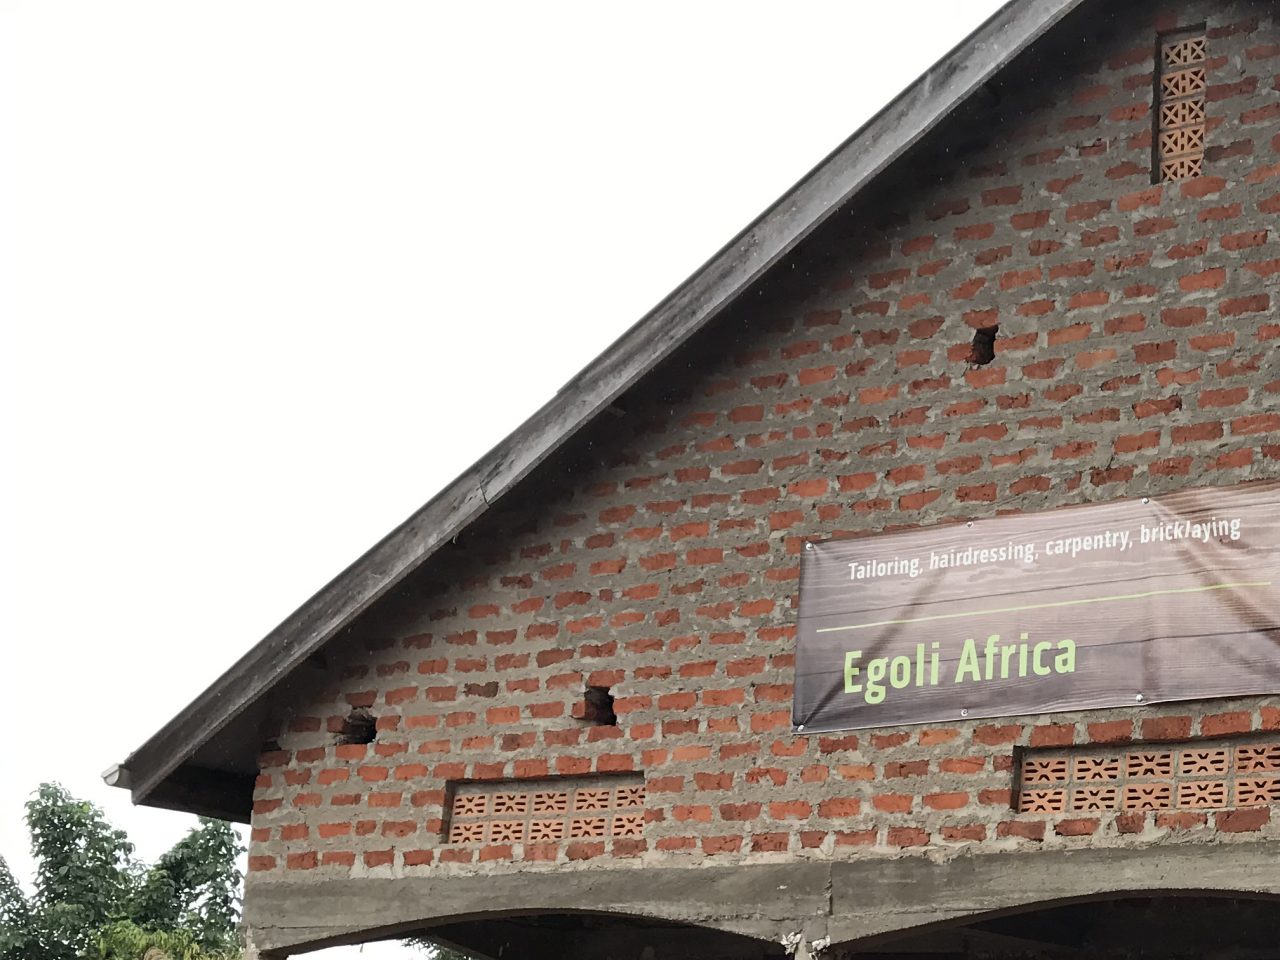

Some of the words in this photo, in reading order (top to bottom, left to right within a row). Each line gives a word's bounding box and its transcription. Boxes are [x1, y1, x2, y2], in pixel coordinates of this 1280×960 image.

[848, 557, 923, 580] Tailoring,
[929, 541, 1039, 570] hairdressing,
[1045, 529, 1133, 558] carpentry,
[1140, 516, 1241, 544] bricklaying
[843, 641, 940, 705] Egoli
[955, 632, 1076, 684] Africa
